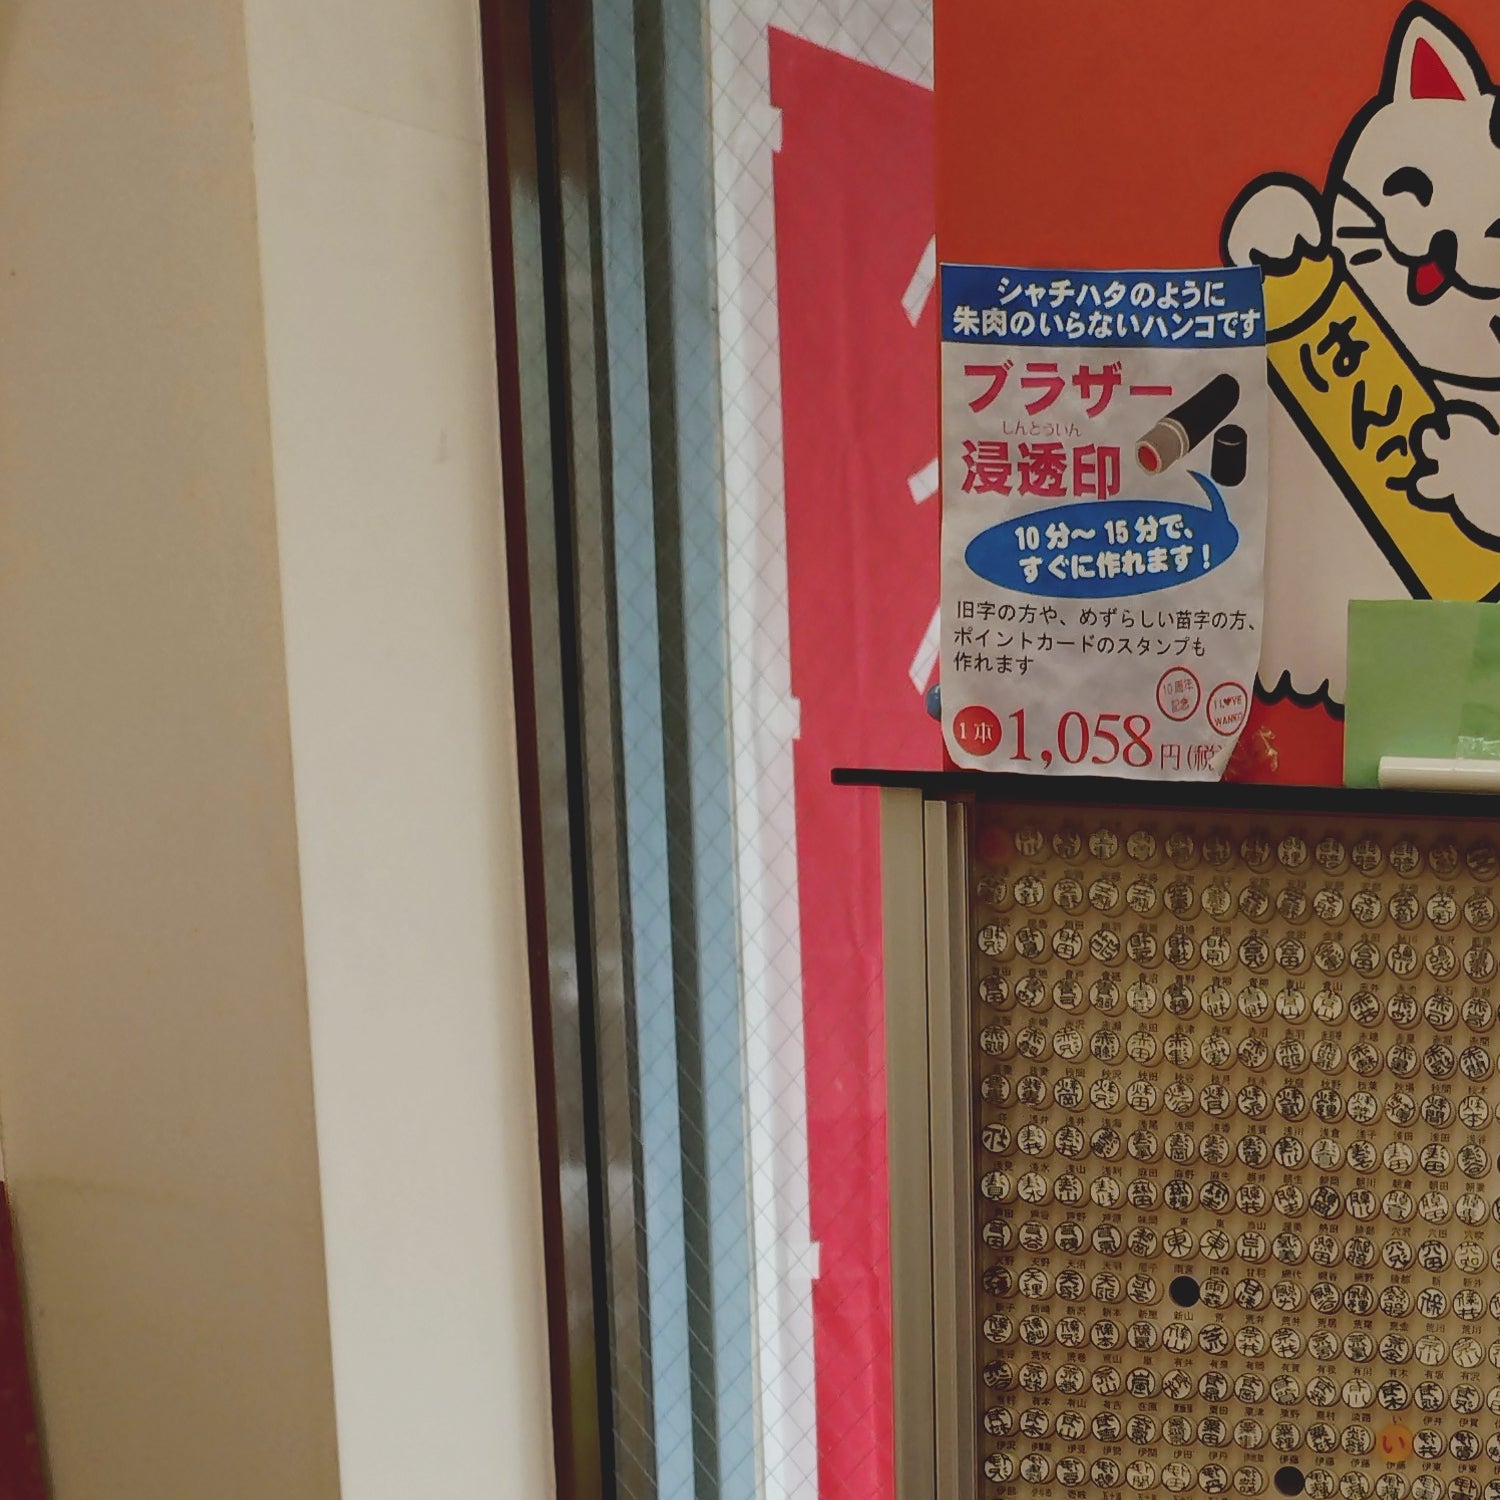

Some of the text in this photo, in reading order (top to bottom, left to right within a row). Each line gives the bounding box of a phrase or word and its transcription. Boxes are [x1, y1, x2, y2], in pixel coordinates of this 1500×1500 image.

[997, 276, 1227, 310] シャチハタのように
[953, 305, 1261, 341] 朱肉のいらないハンコです
[964, 360, 1173, 418] ブラザー
[1002, 420, 1082, 438] しんとういん
[961, 439, 1121, 500] 浸透印
[954, 626, 1206, 658] ポイントカードのスタンプも
[953, 651, 1034, 676] 作れます
[1008, 708, 1154, 770] 1,058
